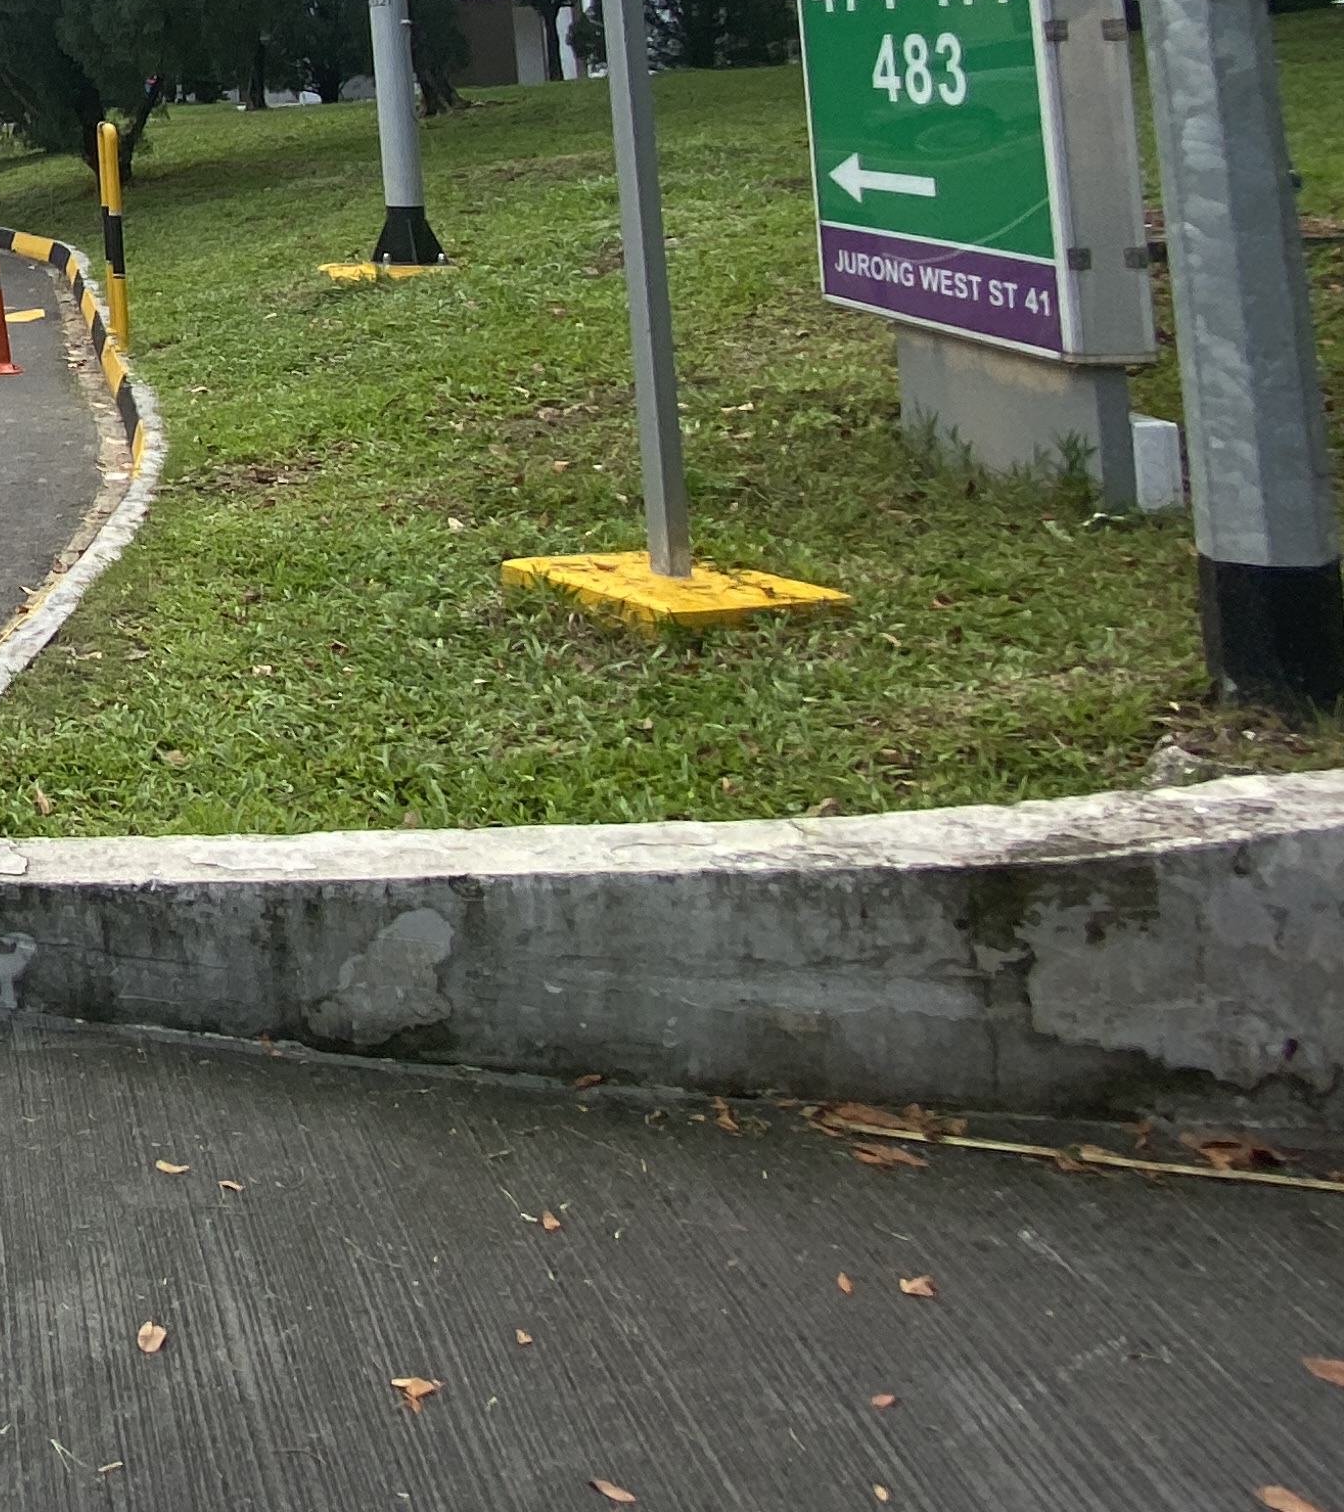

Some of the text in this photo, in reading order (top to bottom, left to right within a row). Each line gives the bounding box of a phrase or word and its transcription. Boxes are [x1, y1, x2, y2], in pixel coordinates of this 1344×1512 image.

[871, 33, 967, 106] 483
[835, 249, 1051, 317] JURONG WEST ST 41
